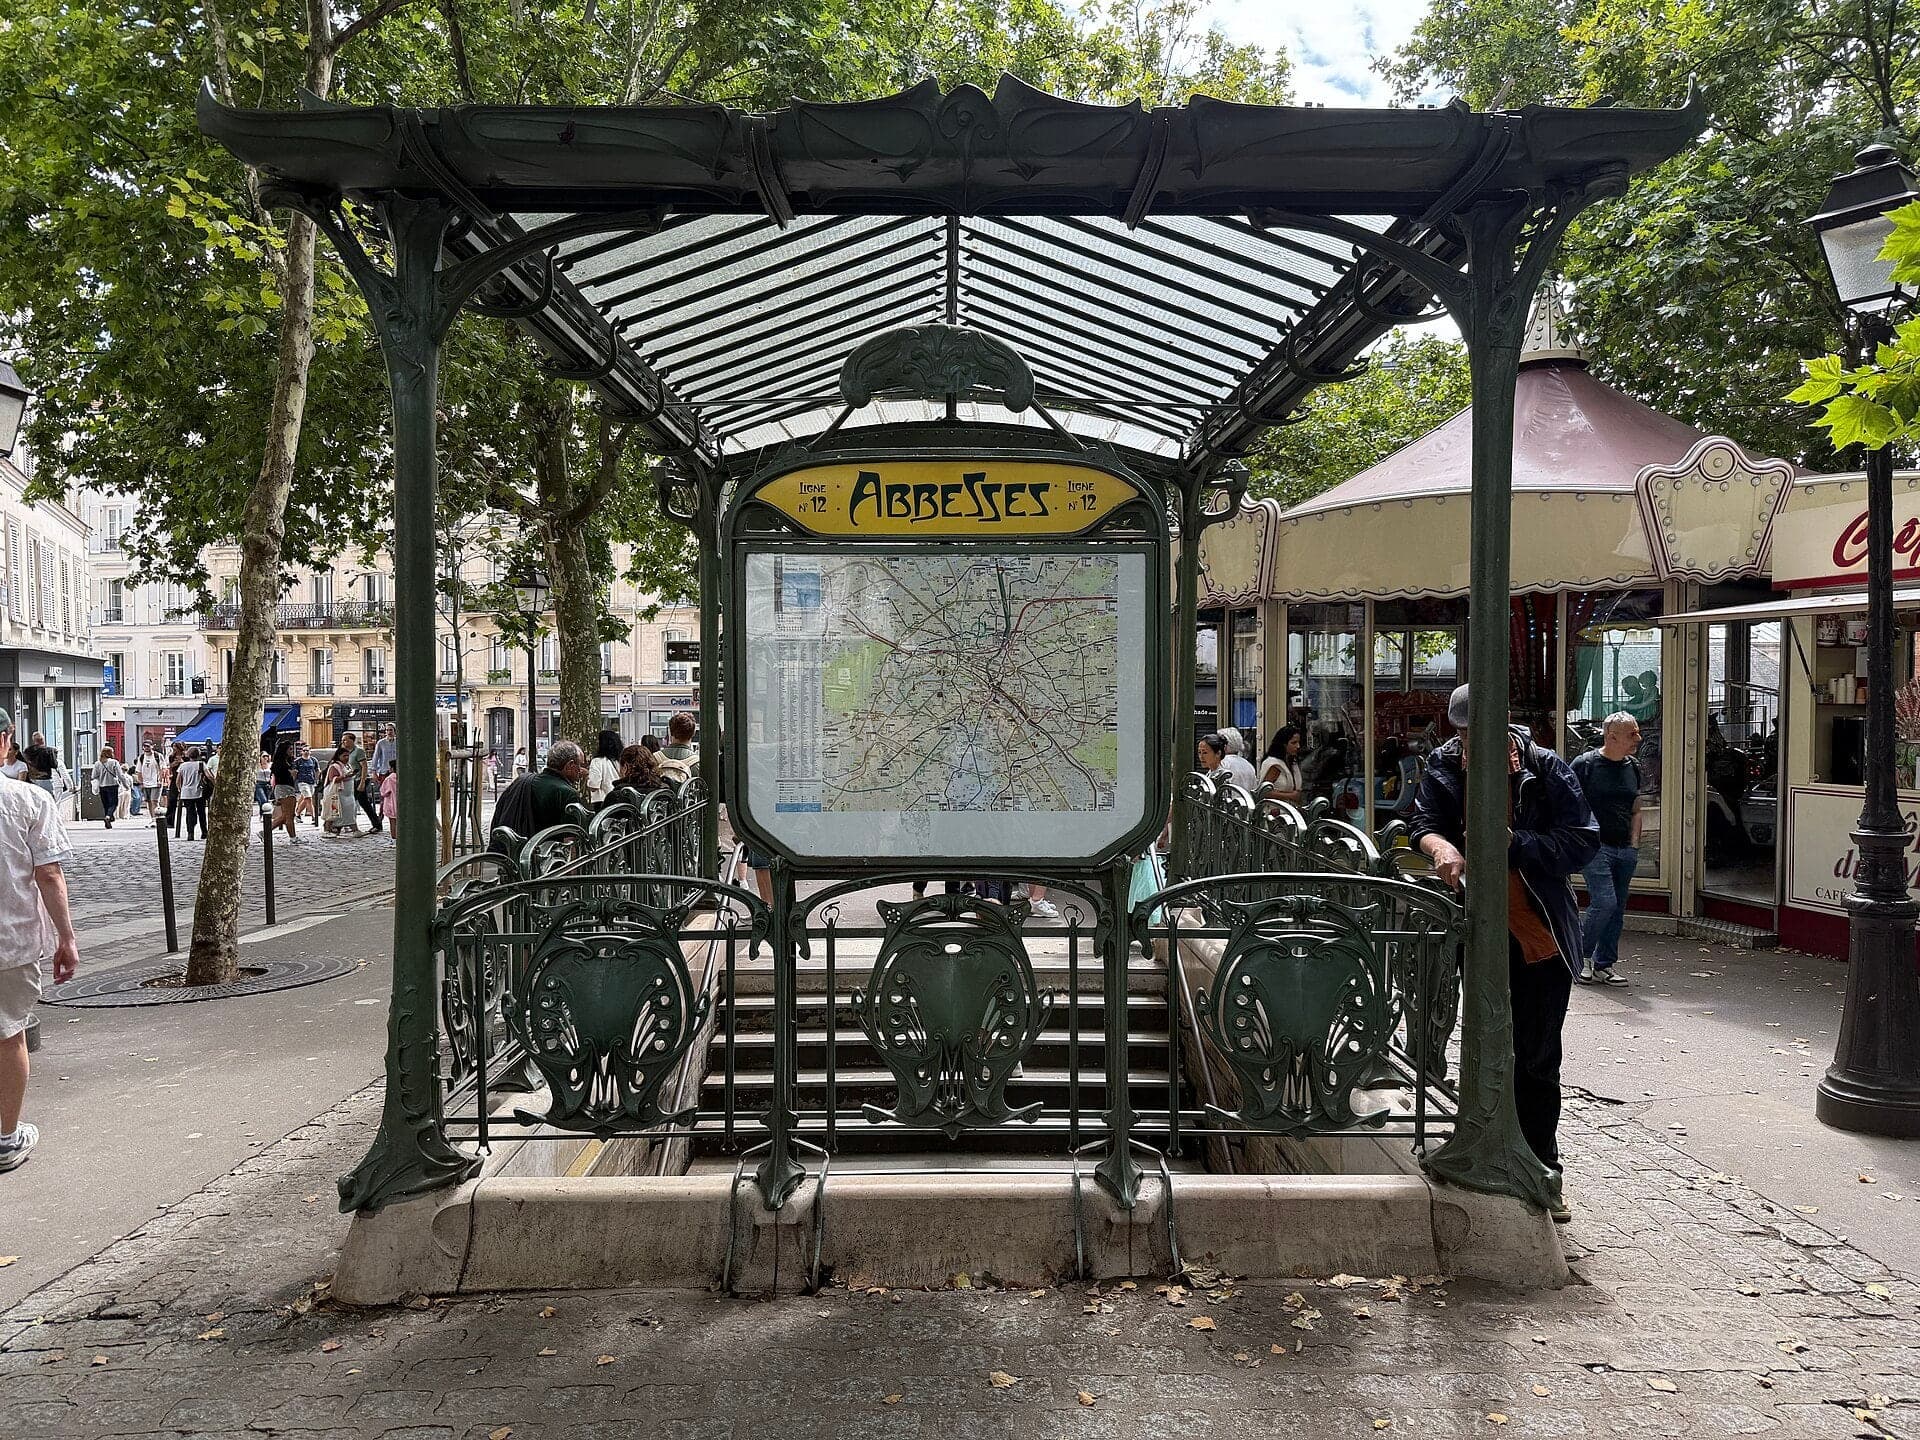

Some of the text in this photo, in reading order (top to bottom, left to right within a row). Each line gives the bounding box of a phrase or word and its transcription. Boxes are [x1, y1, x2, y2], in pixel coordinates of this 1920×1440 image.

[798, 481, 827, 494] LIGNE
[1067, 480, 1095, 493] LIGNE
[810, 495, 827, 513] 12
[849, 470, 1051, 527] ABBESSES
[1080, 493, 1097, 511] 12
